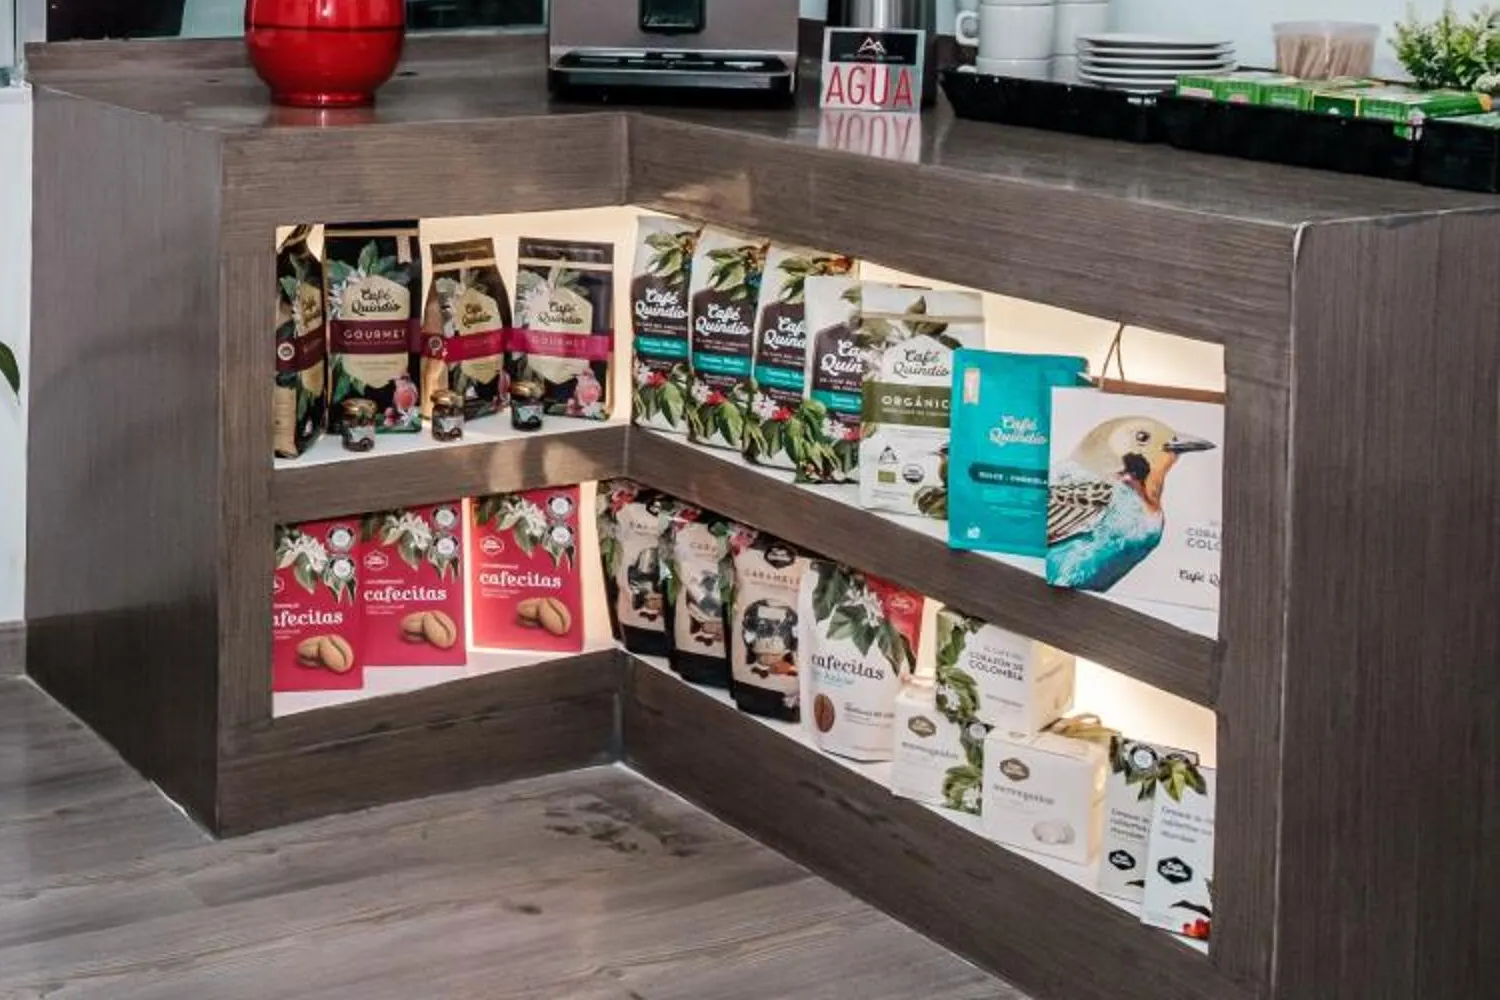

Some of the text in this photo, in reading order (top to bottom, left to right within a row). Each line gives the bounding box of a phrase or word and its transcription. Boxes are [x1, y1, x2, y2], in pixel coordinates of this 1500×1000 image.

[825, 65, 913, 108] AGUA
[644, 287, 680, 306] Café
[707, 303, 741, 322] Café
[343, 328, 405, 339] GOURMET
[777, 316, 805, 336] Caf
[820, 353, 863, 376] Quin
[881, 394, 949, 409] ORGÁNIC
[479, 569, 562, 589] cafecitas
[363, 585, 448, 601] cafecitas
